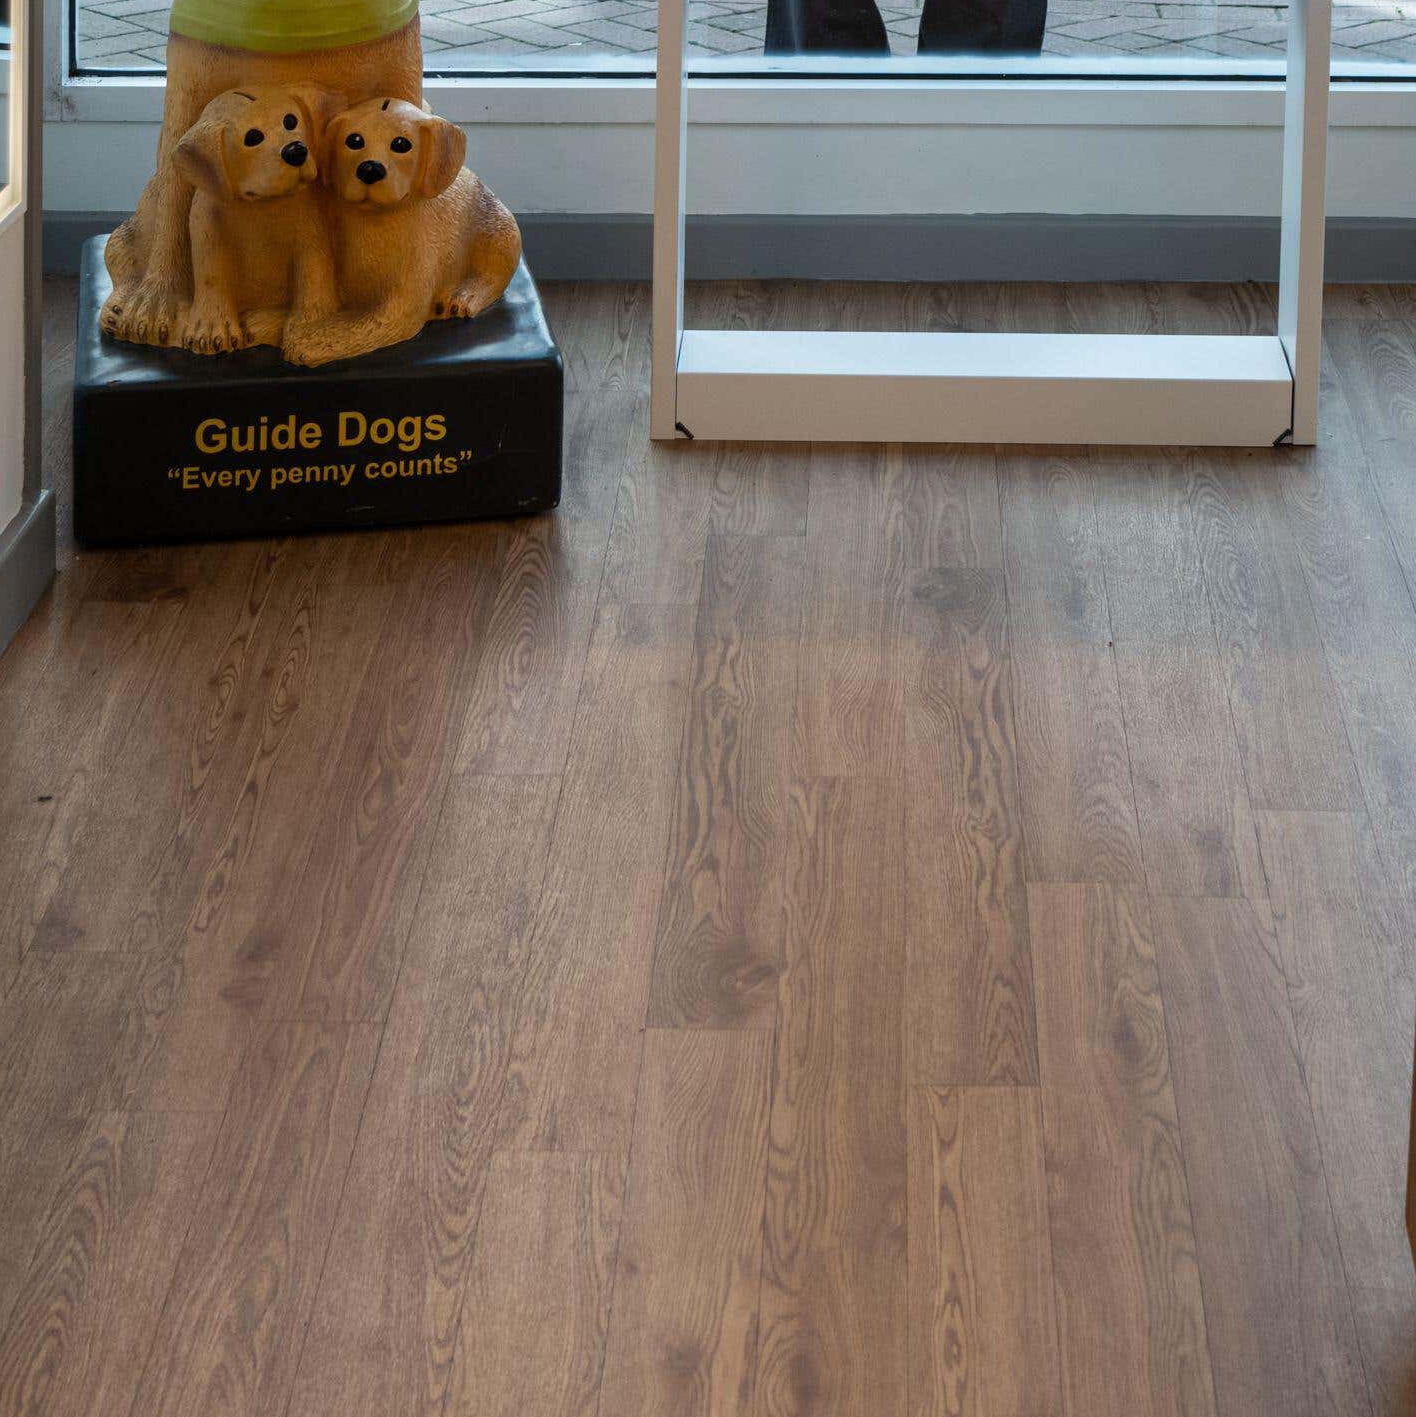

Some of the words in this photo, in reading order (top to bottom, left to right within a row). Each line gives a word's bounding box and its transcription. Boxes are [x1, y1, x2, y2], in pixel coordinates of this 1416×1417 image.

[195, 414, 323, 455] Guide
[338, 410, 448, 451] Dogs
[270, 461, 356, 489] penny
